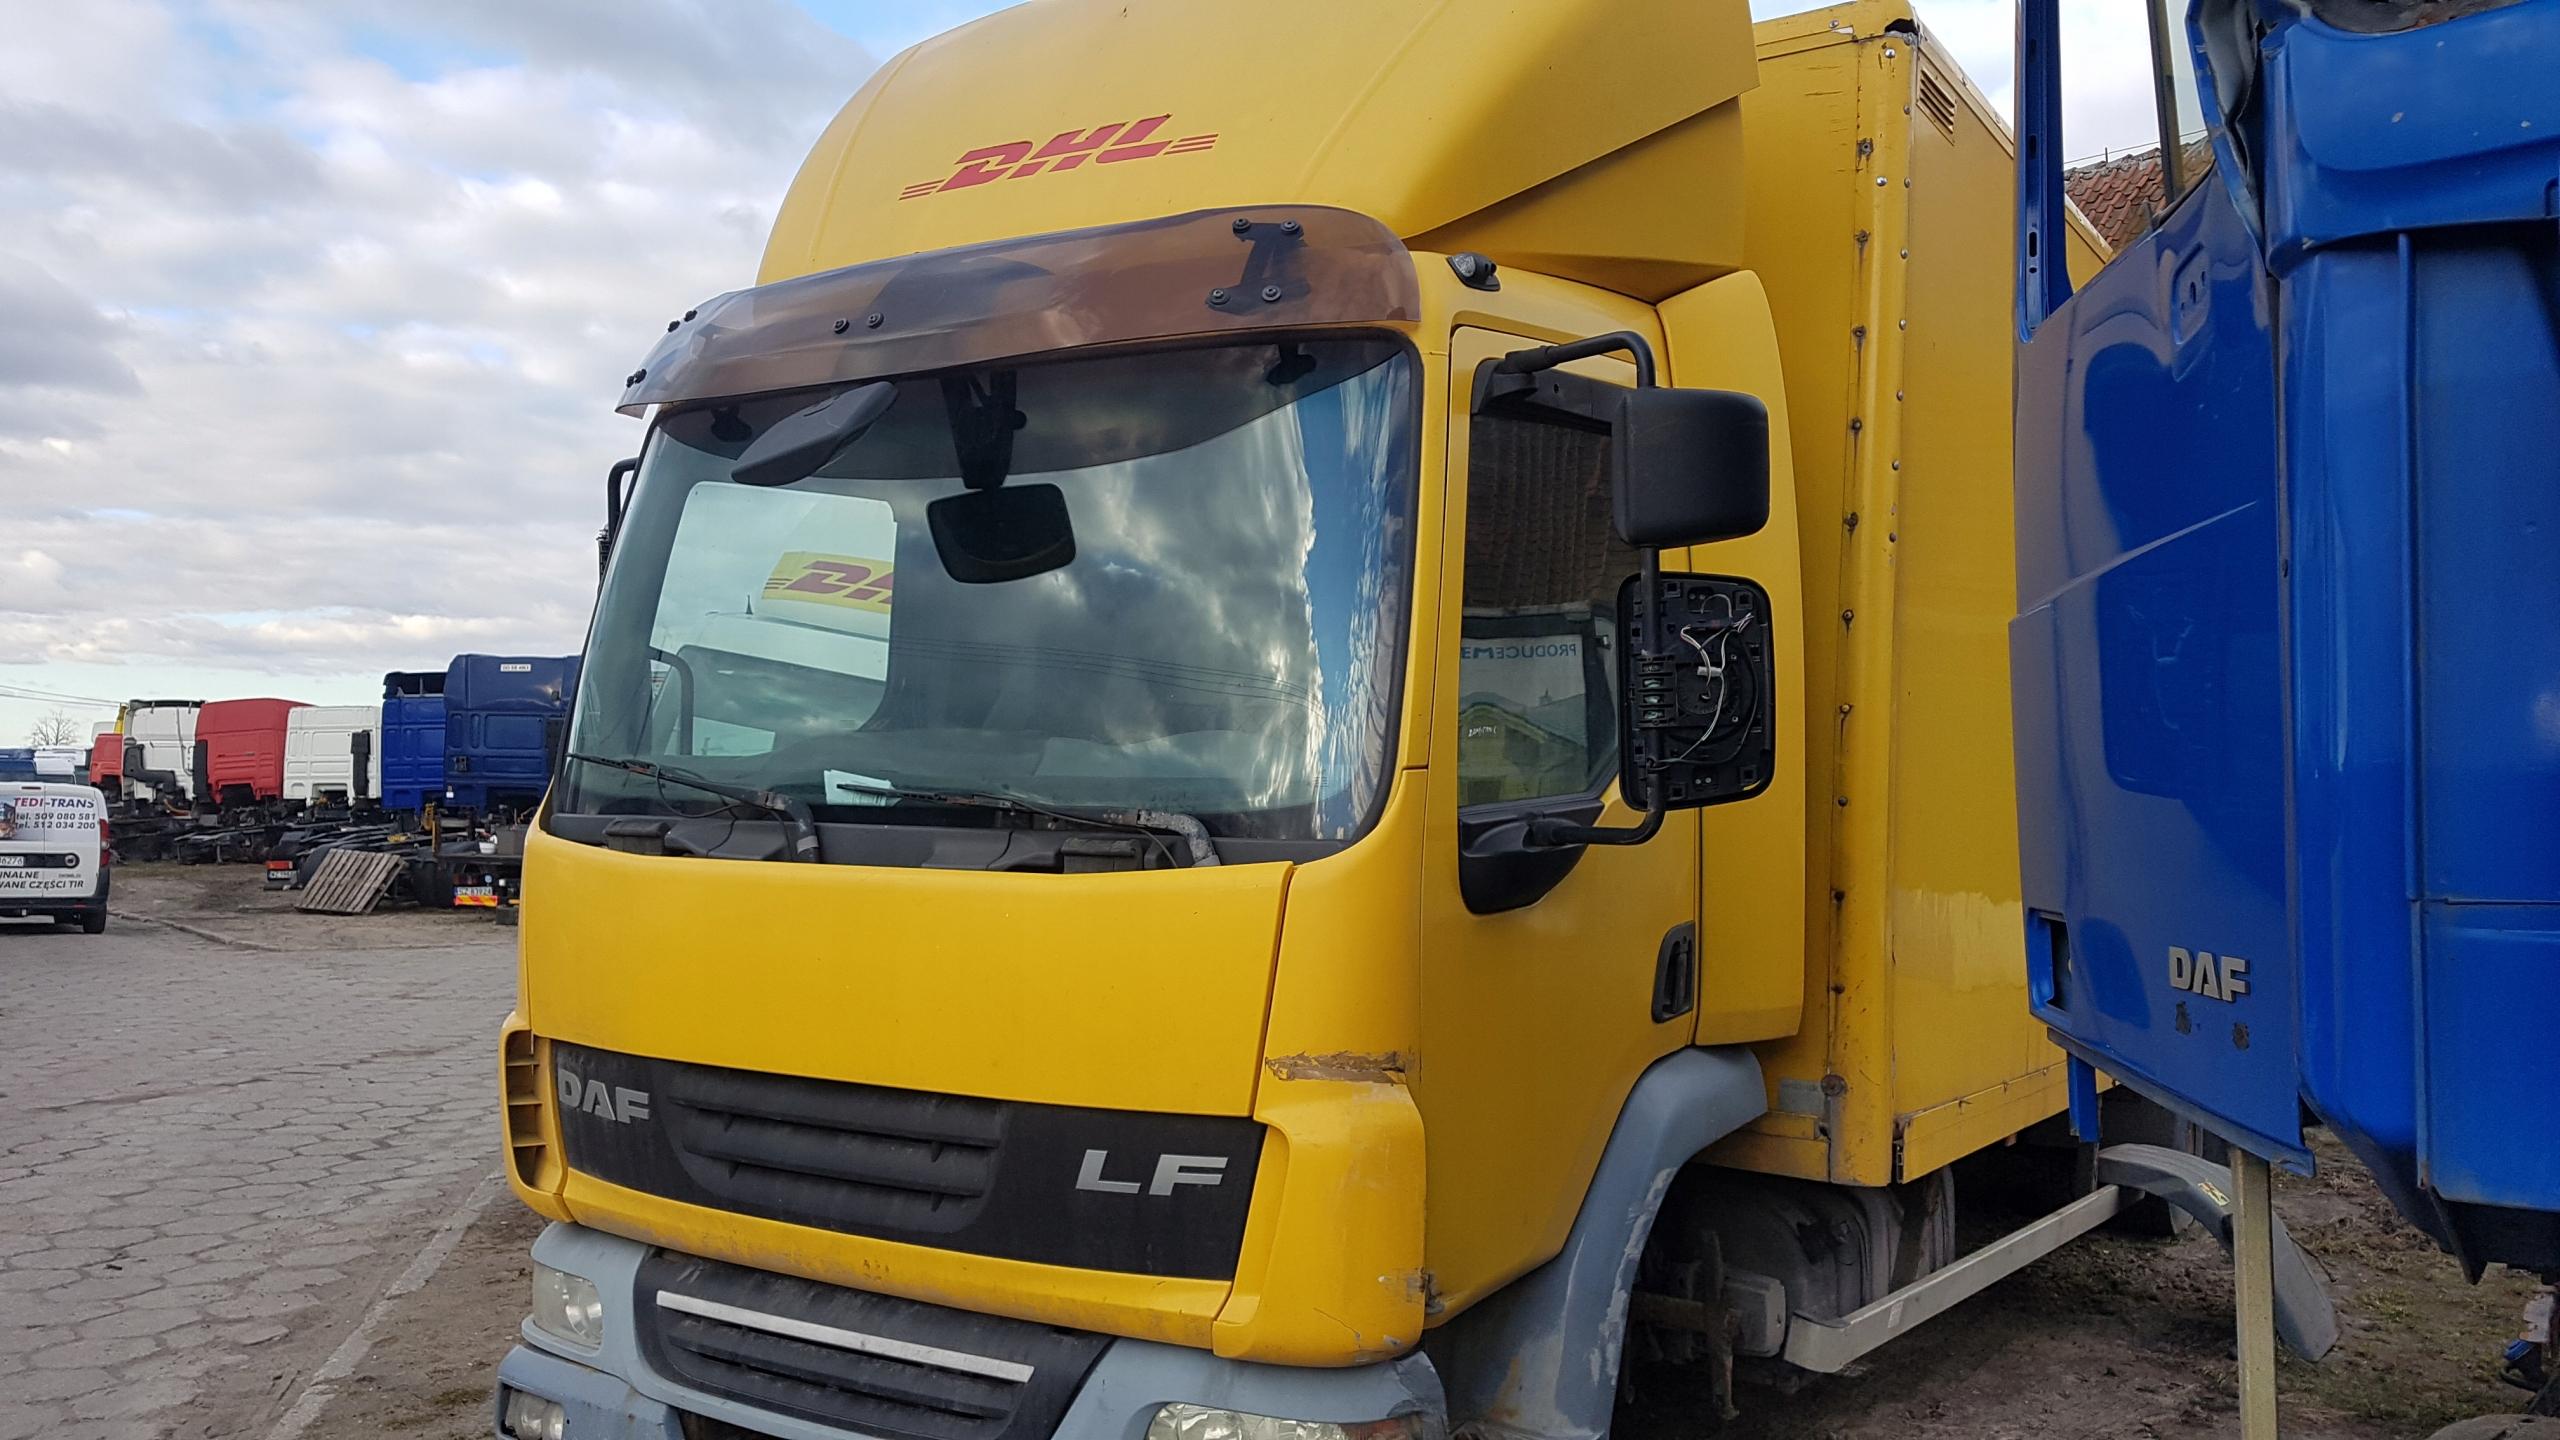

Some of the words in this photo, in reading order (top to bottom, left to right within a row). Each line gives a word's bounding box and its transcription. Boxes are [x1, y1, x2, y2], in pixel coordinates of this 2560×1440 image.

[936, 113, 1173, 193] DHL
[15, 797, 95, 809] TEDI-TRANS
[33, 821, 53, 829] 512
[77, 822, 96, 830] 200
[70, 880, 84, 888] TIR
[2168, 945, 2246, 1002] DAF
[557, 1067, 650, 1125] DAF
[1075, 1149, 1229, 1196] LF
